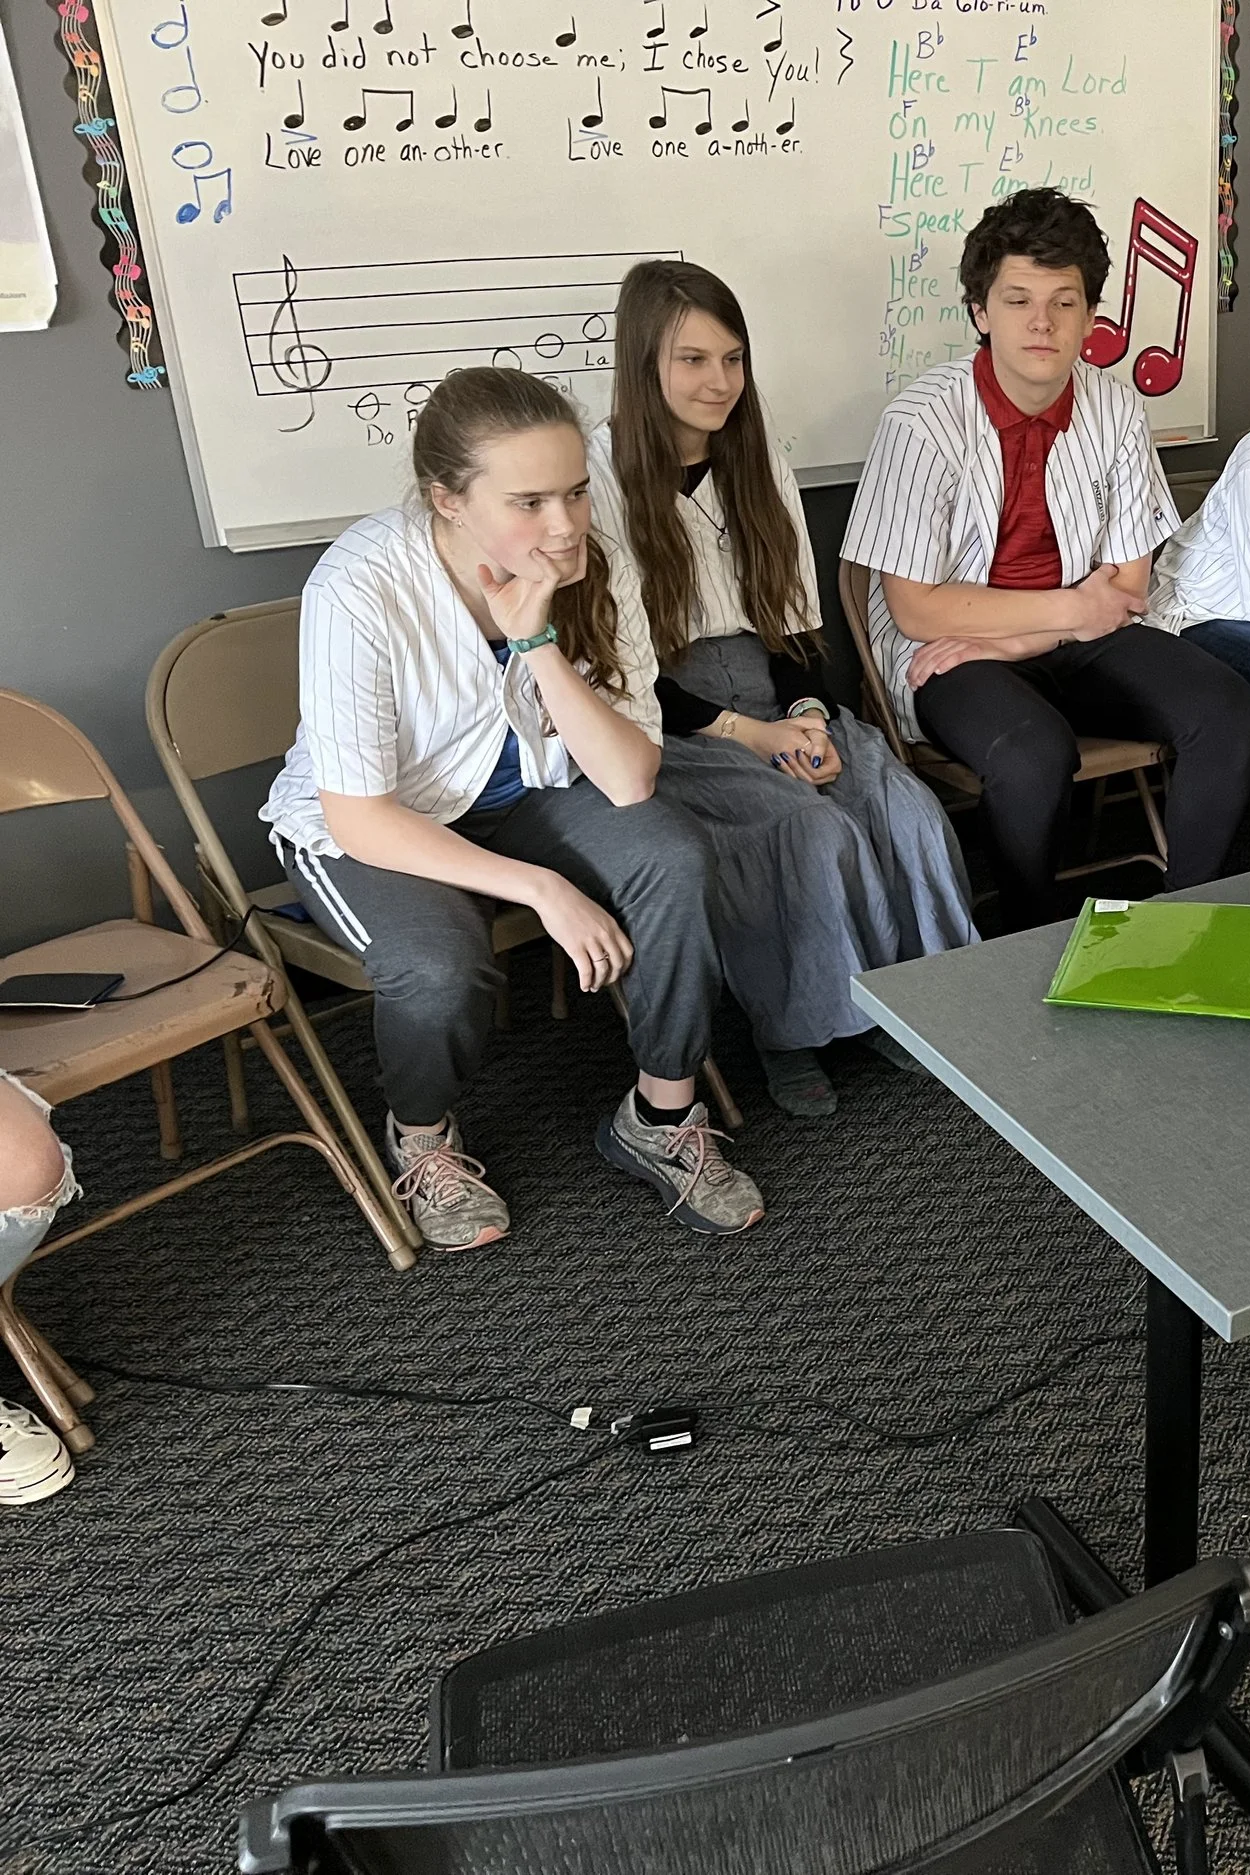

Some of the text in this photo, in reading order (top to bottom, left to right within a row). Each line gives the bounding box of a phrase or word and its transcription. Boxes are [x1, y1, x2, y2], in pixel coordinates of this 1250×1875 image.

[322, 35, 366, 68] did
[387, 32, 437, 67] not
[460, 37, 558, 68] choose
[577, 48, 626, 72] me;
[642, 42, 669, 72] I
[682, 40, 749, 73] chose
[888, 40, 950, 98] Here
[1008, 74, 1047, 97] am
[1061, 53, 1127, 95] Lord
[265, 133, 323, 170] Love
[344, 143, 386, 167] one
[568, 117, 624, 161] Love
[652, 140, 689, 159] one
[954, 110, 996, 152] my
[890, 151, 948, 203] Here
[992, 175, 1029, 198] am
[890, 255, 941, 299] Here
[585, 350, 610, 366] La
[367, 423, 394, 446] Do
